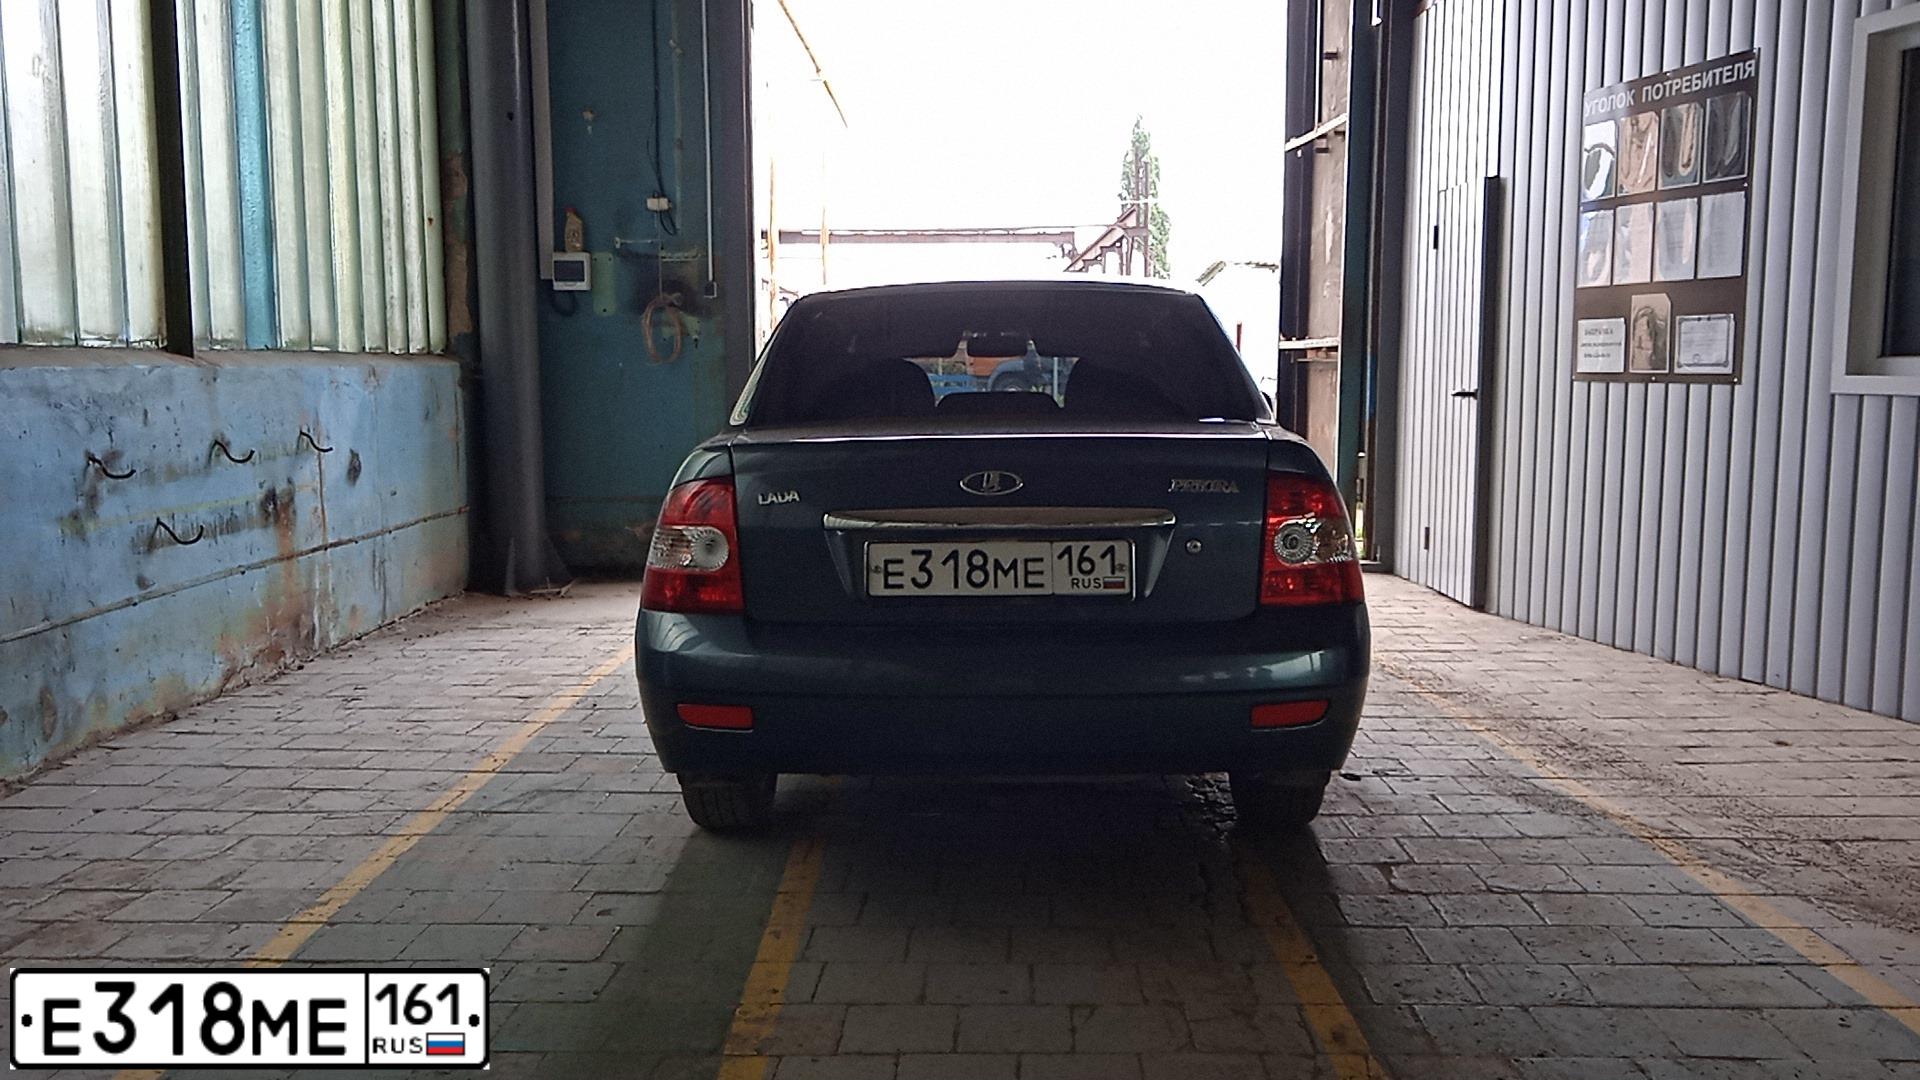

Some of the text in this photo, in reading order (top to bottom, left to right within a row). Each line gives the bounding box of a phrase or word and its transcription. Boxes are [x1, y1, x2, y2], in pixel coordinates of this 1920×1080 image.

[1585, 60, 1756, 116] УГОЛОК ПОТРЕБИТЕЛЯ
[758, 491, 800, 505] LADA
[1057, 545, 1118, 576] 161
[1071, 577, 1102, 590] RUS
